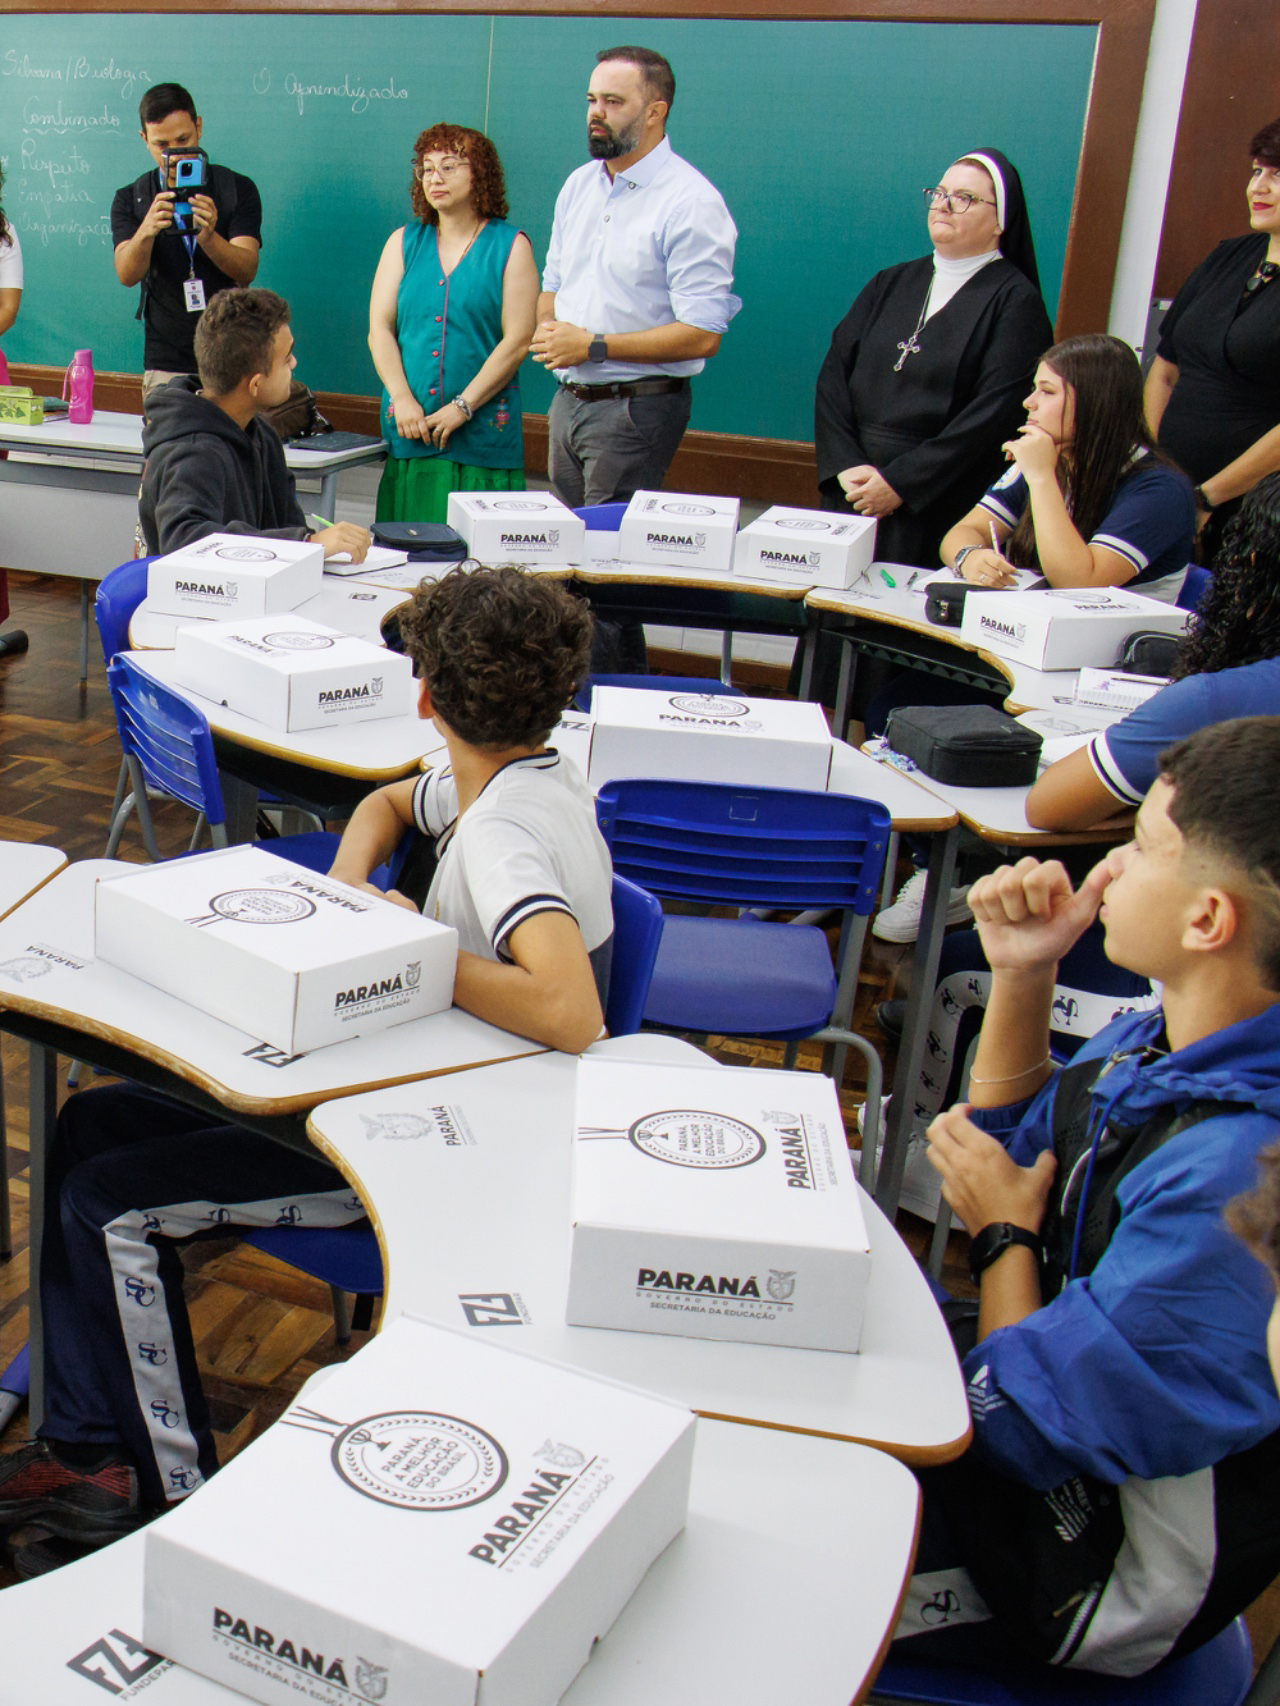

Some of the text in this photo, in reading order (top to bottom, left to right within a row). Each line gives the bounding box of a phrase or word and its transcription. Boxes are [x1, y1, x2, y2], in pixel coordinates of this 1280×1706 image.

[22, 96, 120, 126] Combinado
[19, 212, 111, 247] Organizaçã
[500, 533, 547, 543] PARANÁ
[646, 533, 693, 546] PARANÁ
[760, 549, 807, 564] PARANÁ
[175, 580, 225, 596] PARANÁ
[980, 615, 1016, 637] PARANÁ
[318, 683, 370, 704] PARANÁ
[335, 973, 403, 1008] PARANÁ
[427, 1105, 462, 1146] PARANÁ
[774, 1127, 812, 1190] PARANÁ
[637, 1267, 761, 1298] PARANÁ
[636, 1292, 701, 1304] GOVERNO
[739, 1302, 794, 1313] ESTADO
[650, 1301, 777, 1321] SECRETARIA DA EDUCAÇÃO
[401, 1437, 442, 1473] MELHOR
[406, 1440, 459, 1489] EDUCAÇÃO
[425, 1451, 468, 1489] DO BRASIL
[467, 1467, 572, 1565] PARANÁ
[213, 1606, 349, 1688] PARANÁ
[228, 1652, 290, 1687] SECRETARIA
[291, 1680, 308, 1694] DA
